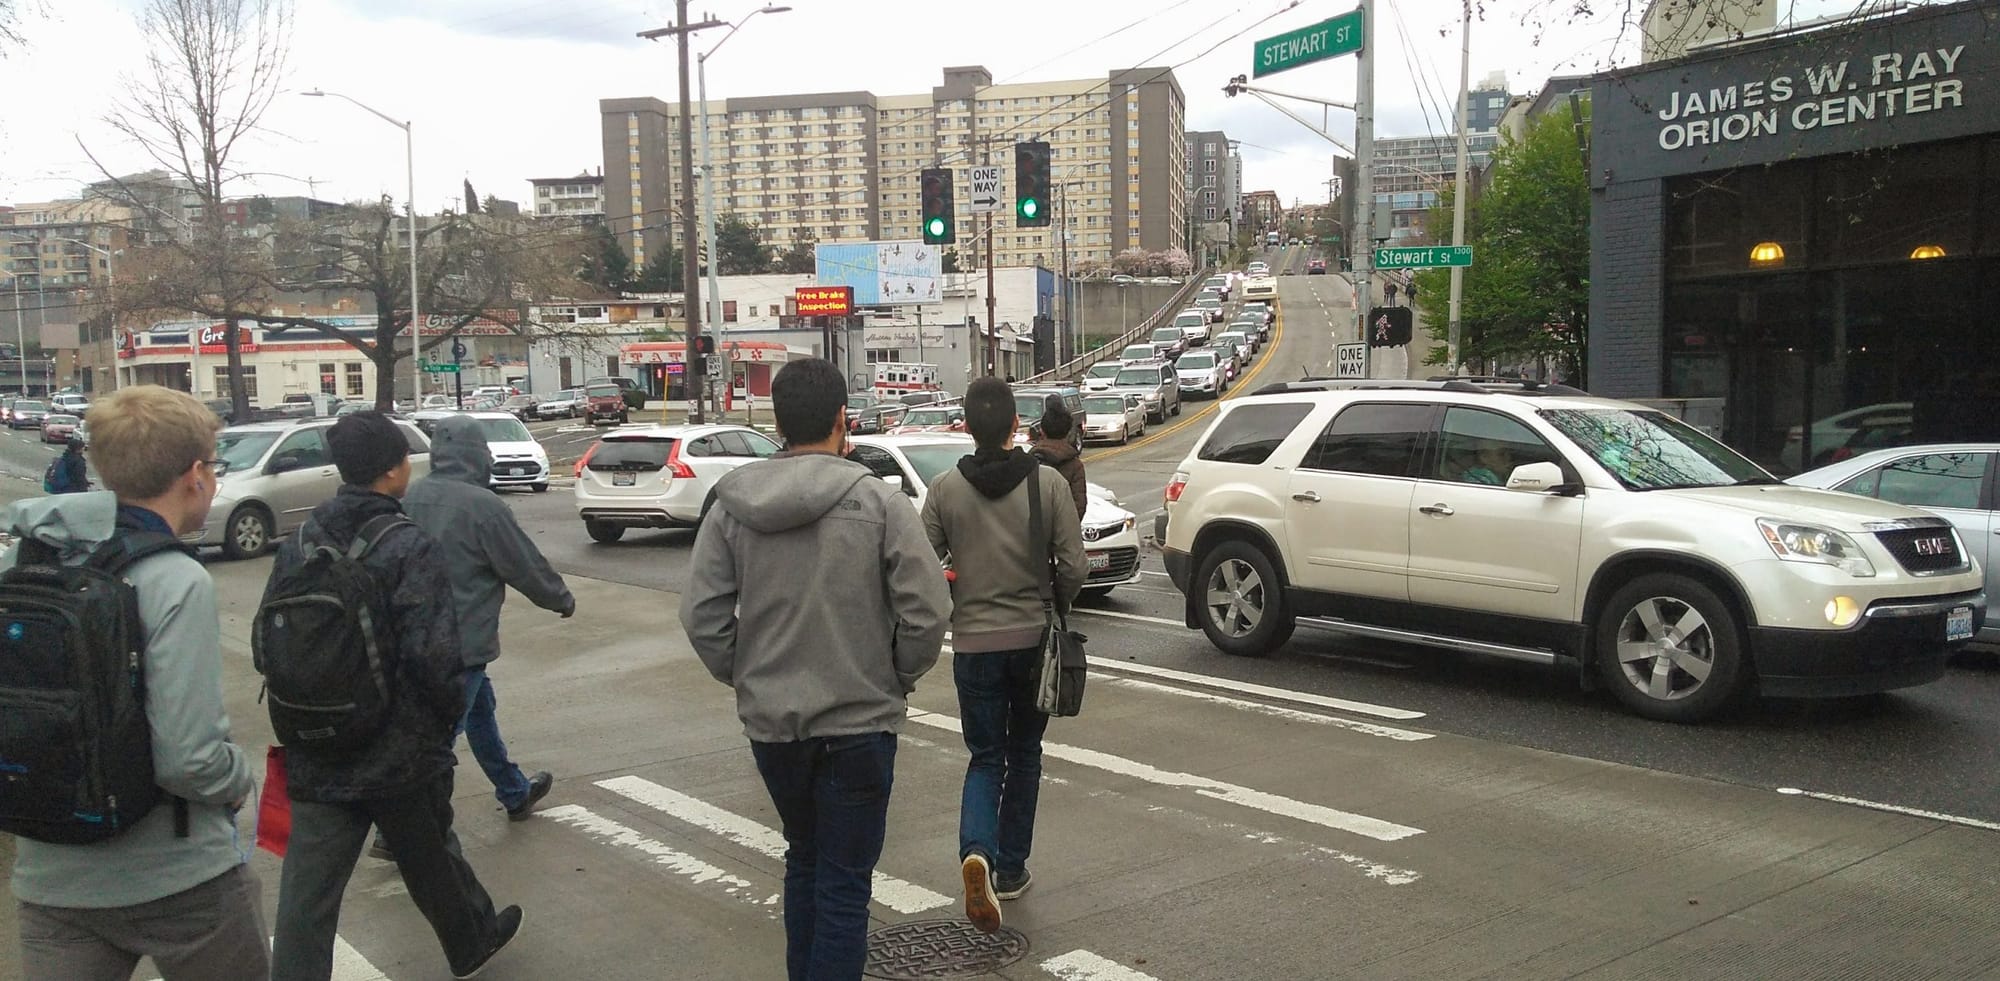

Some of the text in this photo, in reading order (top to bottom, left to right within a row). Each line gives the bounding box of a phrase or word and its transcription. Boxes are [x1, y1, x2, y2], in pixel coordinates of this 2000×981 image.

[1263, 26, 1351, 66] STEWART ST
[1658, 45, 1965, 121] JAMES W. RAY
[1658, 79, 1964, 150] ORION CENTER
[973, 169, 997, 180] ONE
[974, 181, 997, 193] WAY
[1380, 247, 1471, 265] Stewart St 1300
[798, 303, 847, 312] Inspection
[1340, 348, 1363, 360] ONE
[1340, 362, 1363, 375] WAY
[1914, 537, 1953, 555] GMC
